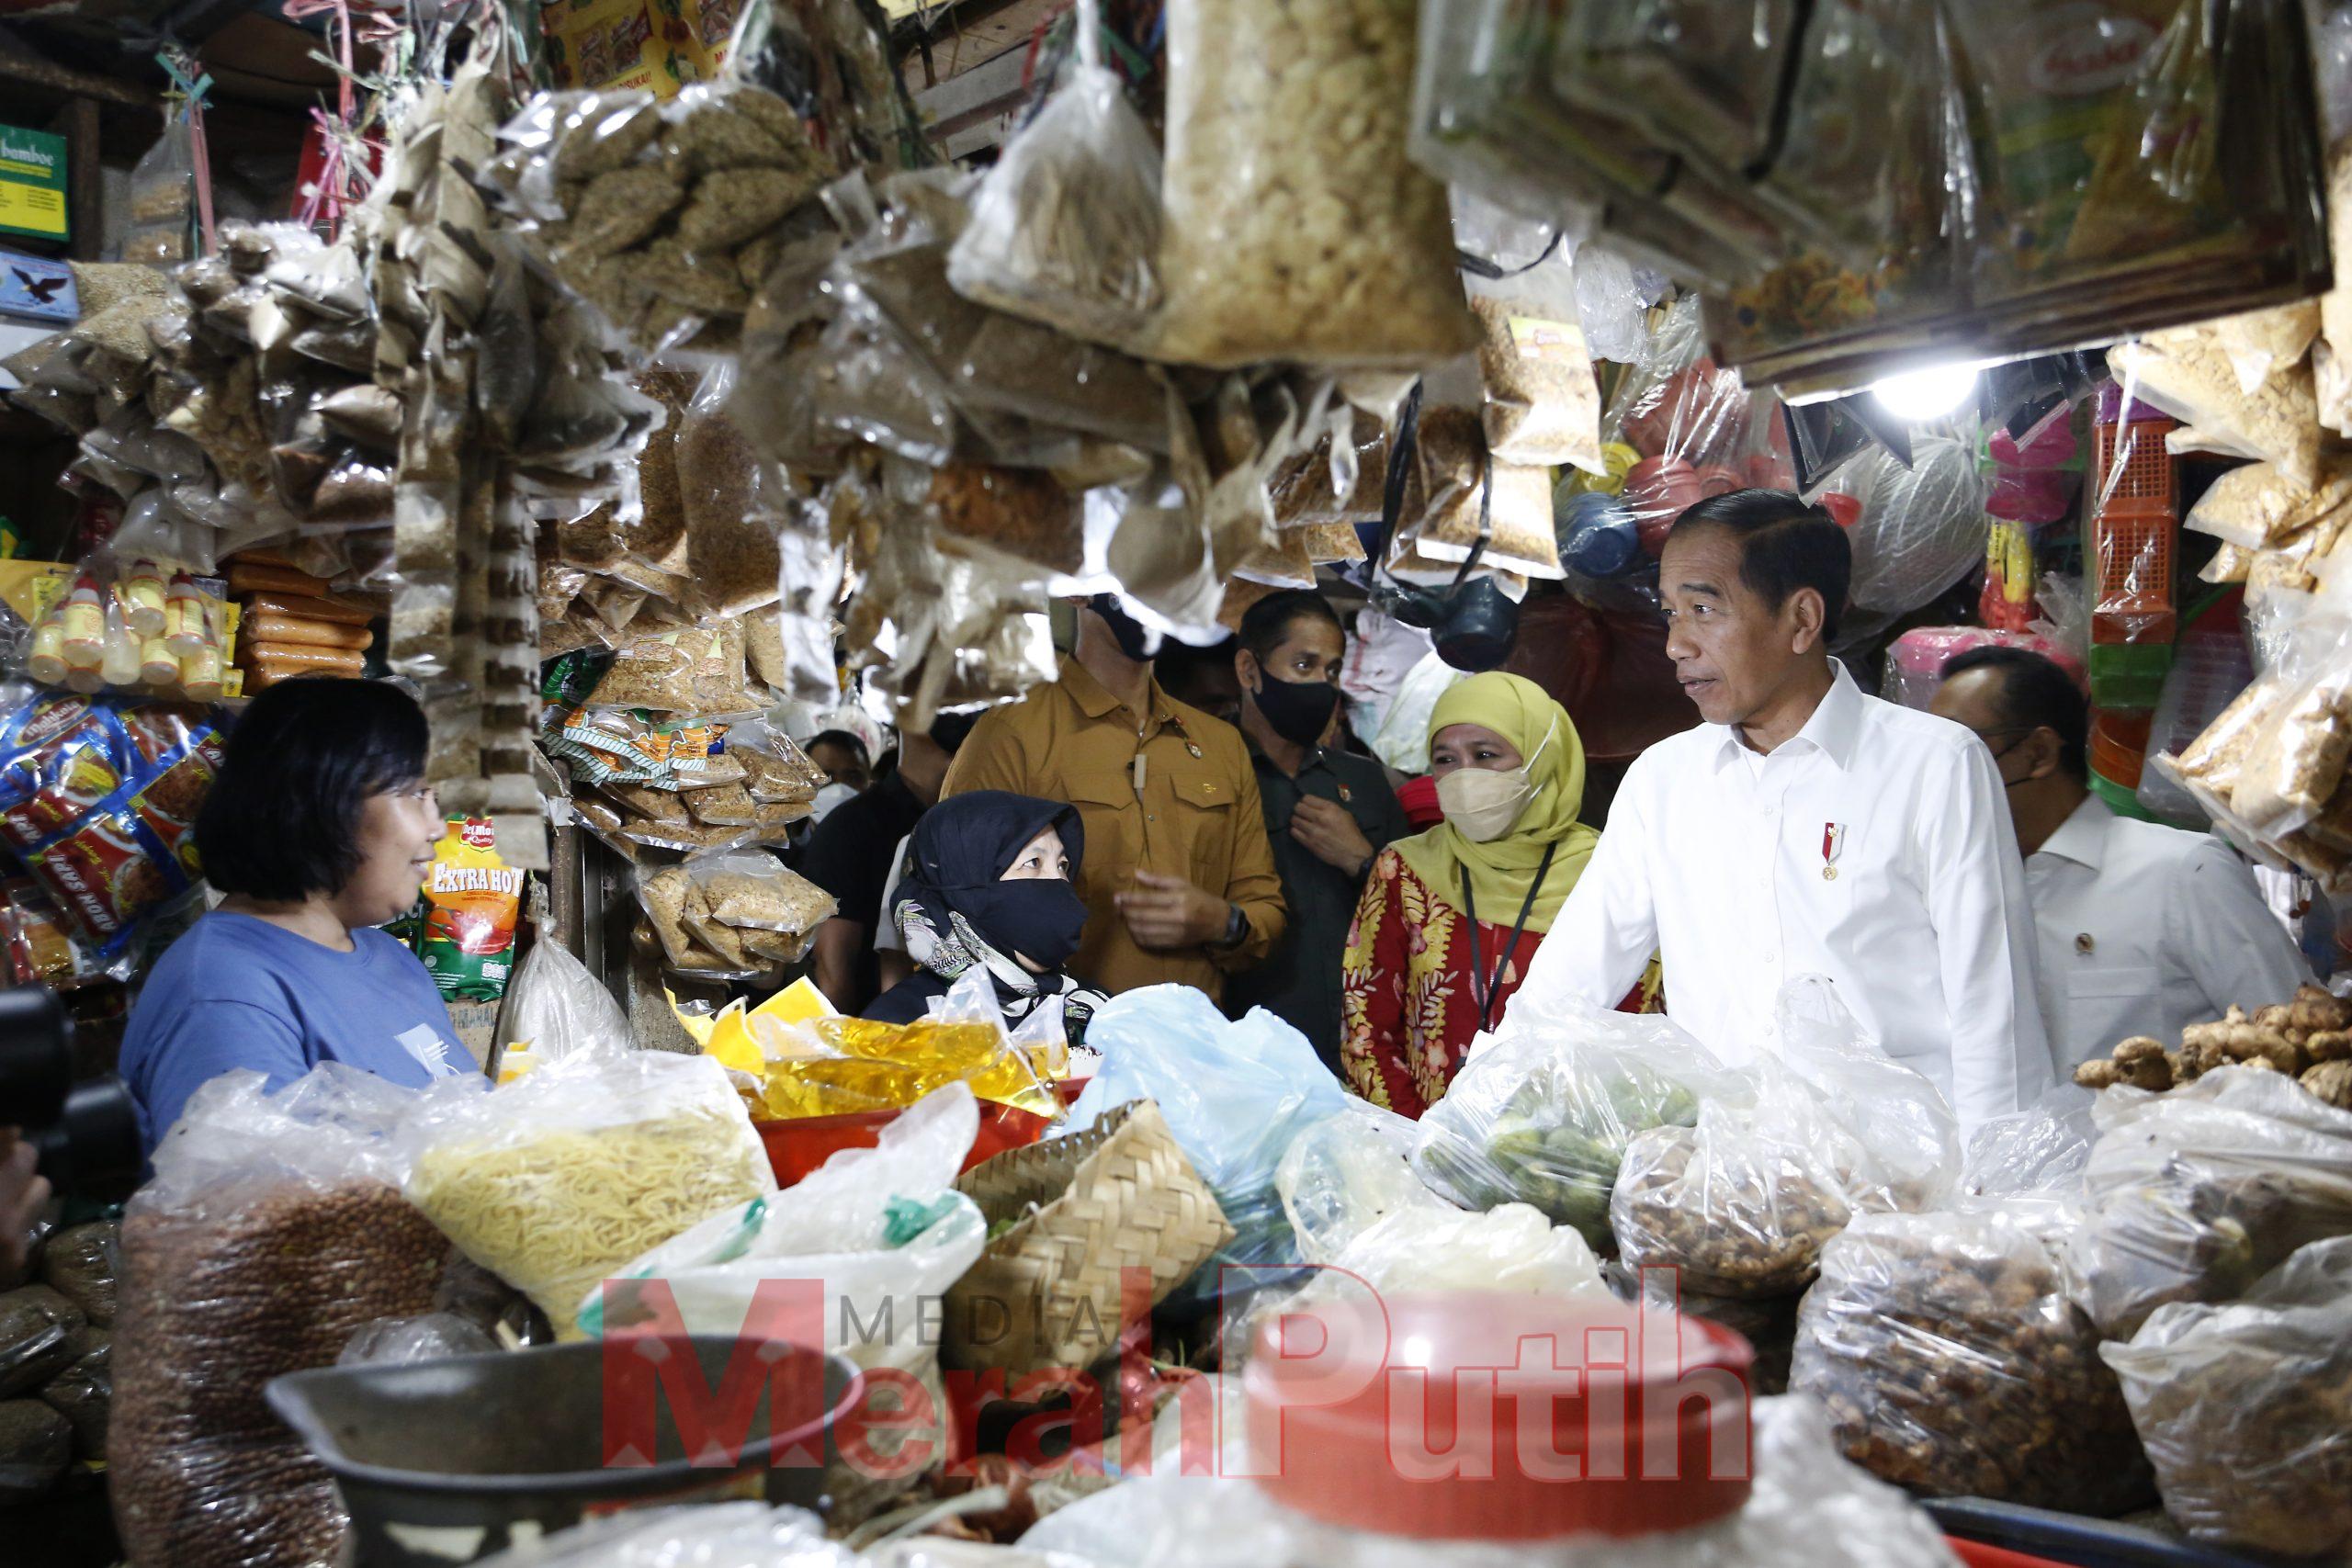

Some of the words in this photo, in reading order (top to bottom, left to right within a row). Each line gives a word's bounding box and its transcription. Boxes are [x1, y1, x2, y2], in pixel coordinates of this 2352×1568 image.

[47, 854, 88, 893] SAPI
[433, 863, 489, 893] EXTRA
[490, 866, 525, 898] HOT
[77, 892, 119, 931] ABON
